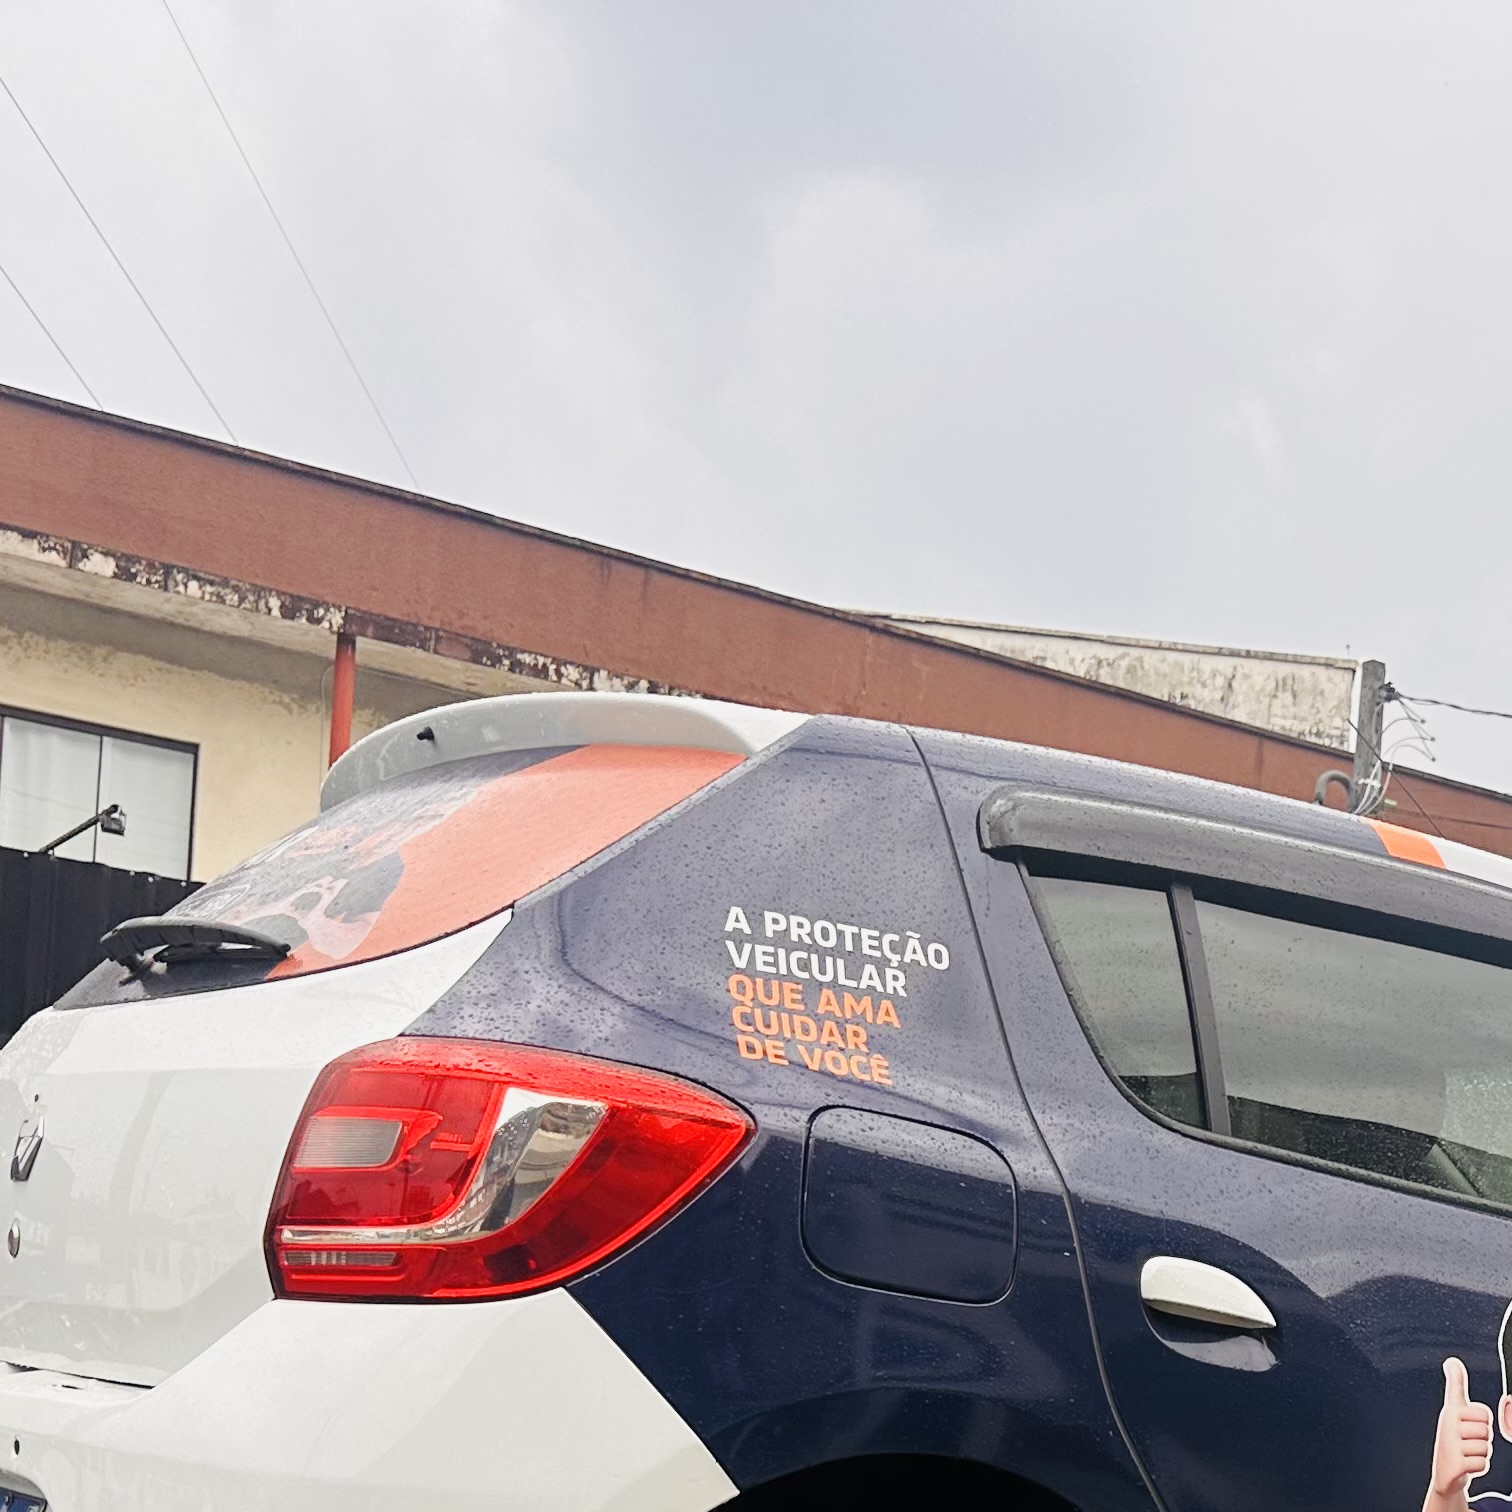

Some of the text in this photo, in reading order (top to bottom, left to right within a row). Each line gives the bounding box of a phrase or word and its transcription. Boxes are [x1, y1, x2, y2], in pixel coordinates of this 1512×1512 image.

[724, 905, 950, 970] A PROTEÇÃO
[725, 940, 908, 997] VEICULAR
[727, 973, 901, 1029] QUE AMA
[731, 1005, 869, 1053] CUIDAR
[736, 1034, 893, 1086] DE VOCÊ
